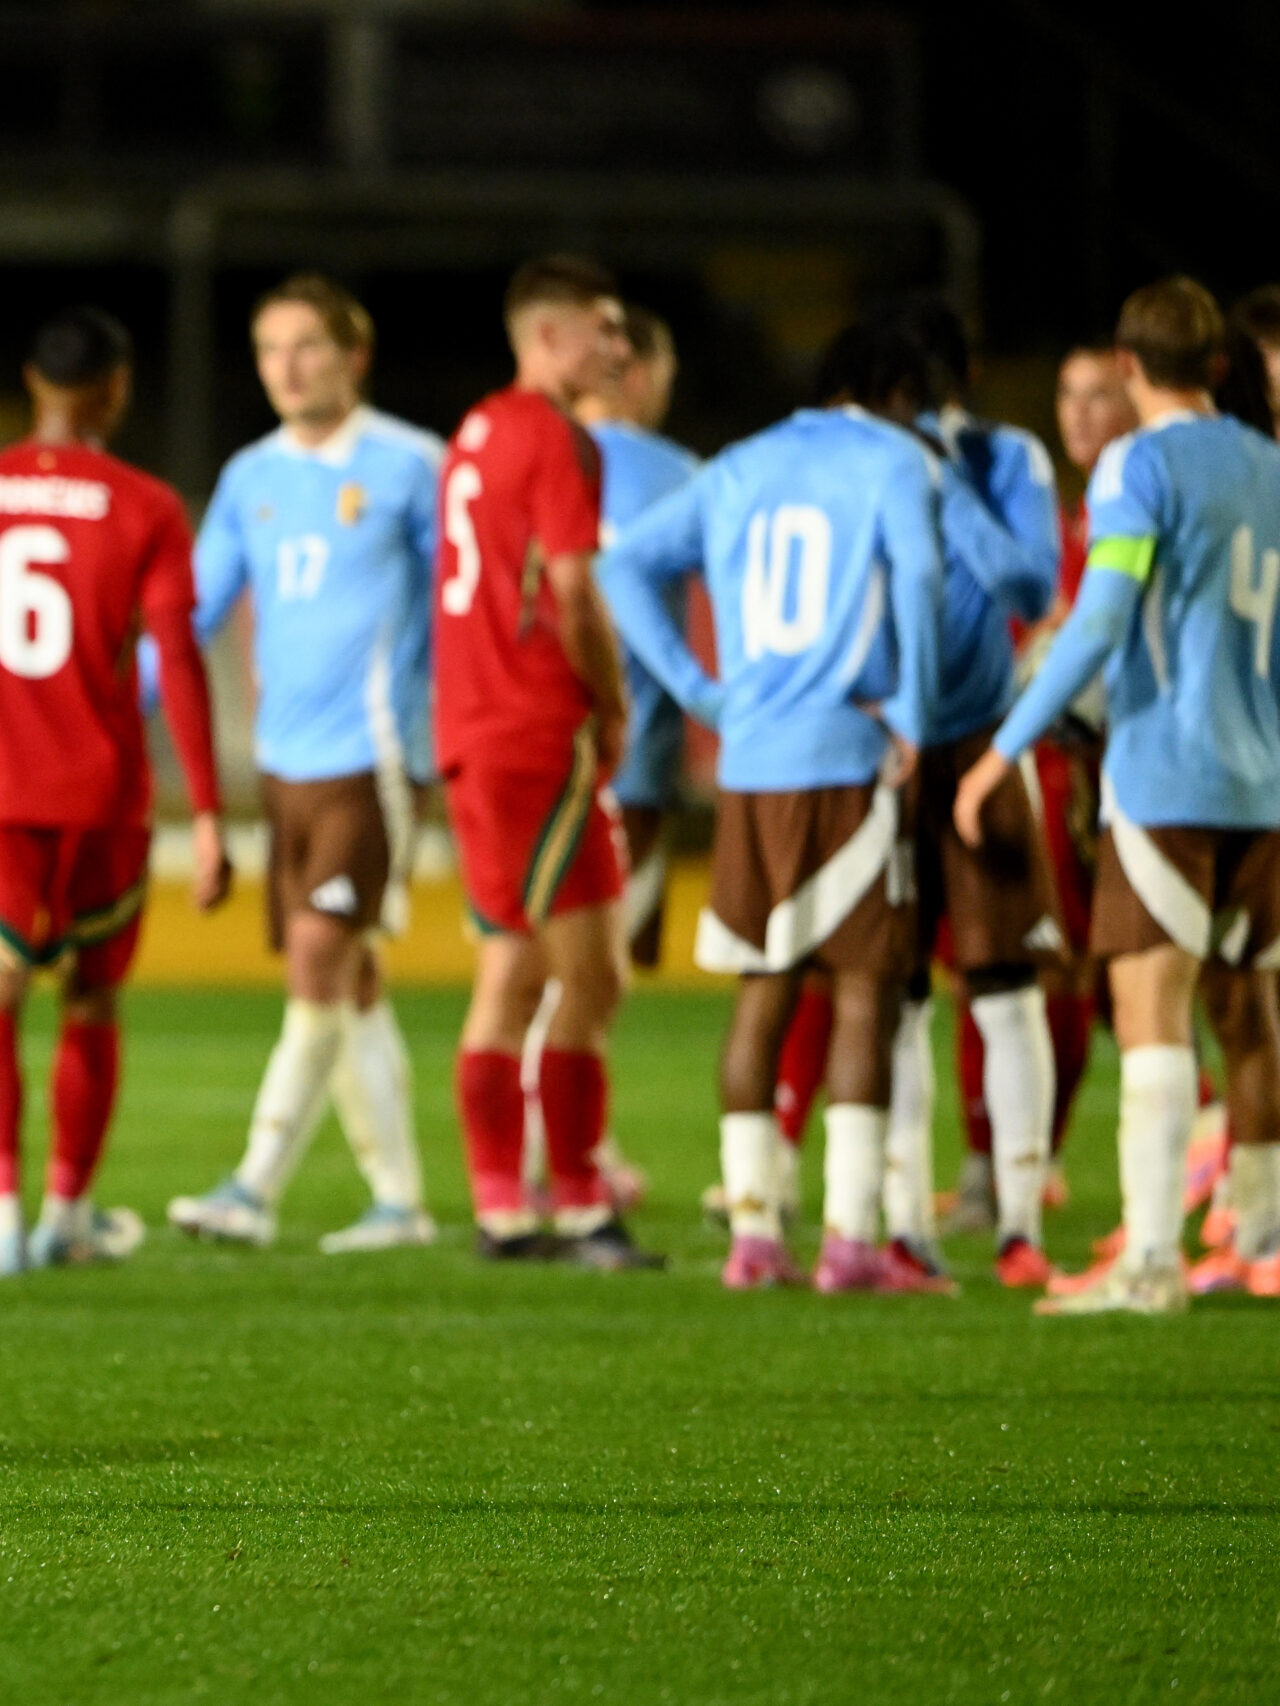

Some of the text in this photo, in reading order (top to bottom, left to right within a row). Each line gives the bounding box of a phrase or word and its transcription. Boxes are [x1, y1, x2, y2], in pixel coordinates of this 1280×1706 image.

[276, 534, 329, 598] 17
[442, 462, 482, 616] 5
[742, 505, 832, 661] 10
[1230, 525, 1280, 679] 4
